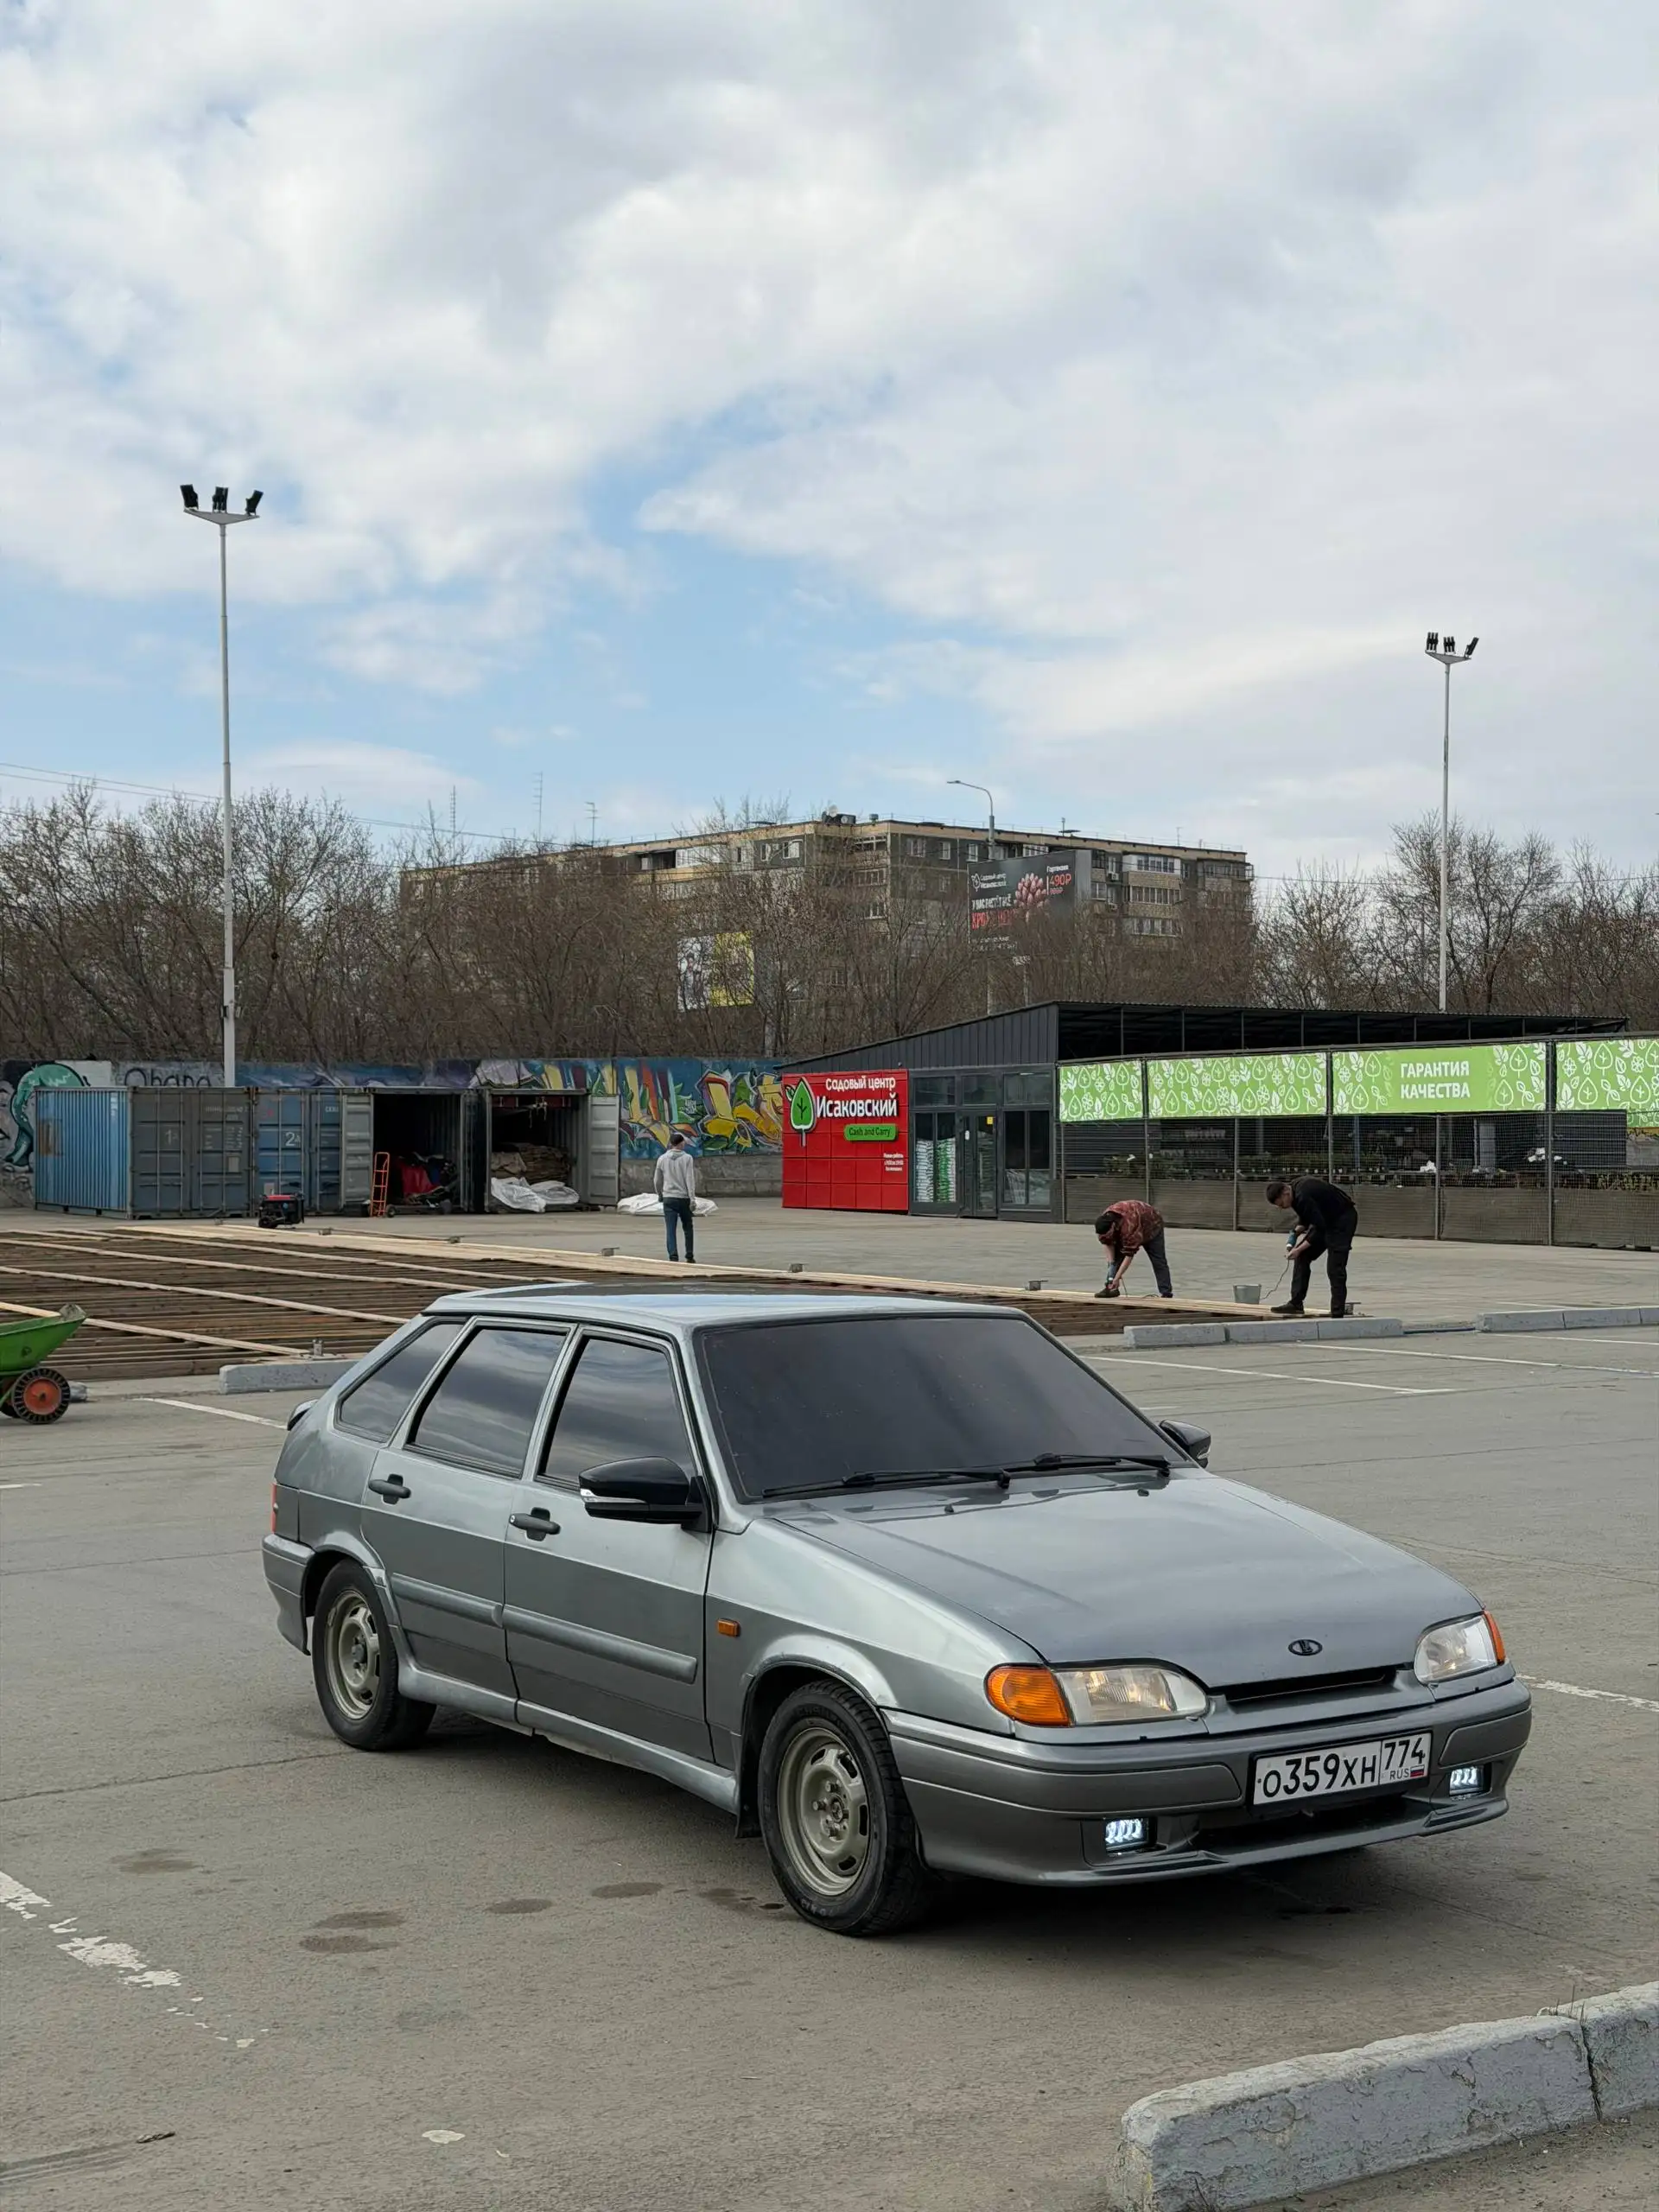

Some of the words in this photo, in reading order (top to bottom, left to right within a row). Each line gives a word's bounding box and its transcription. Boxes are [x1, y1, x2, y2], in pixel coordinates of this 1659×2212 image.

[1400, 1060, 1470, 1078] ГАРАНТИЯ
[825, 1075, 867, 1091] Садовый
[868, 1077, 896, 1091] центр
[1400, 1082, 1471, 1100] КАЧЕСТВА
[817, 1091, 898, 1118] Исаковский
[849, 1127, 862, 1136] Cash
[863, 1127, 874, 1136] and
[875, 1126, 891, 1138] Carry
[1383, 1737, 1426, 1770] 774
[1389, 1767, 1410, 1781] RUS
